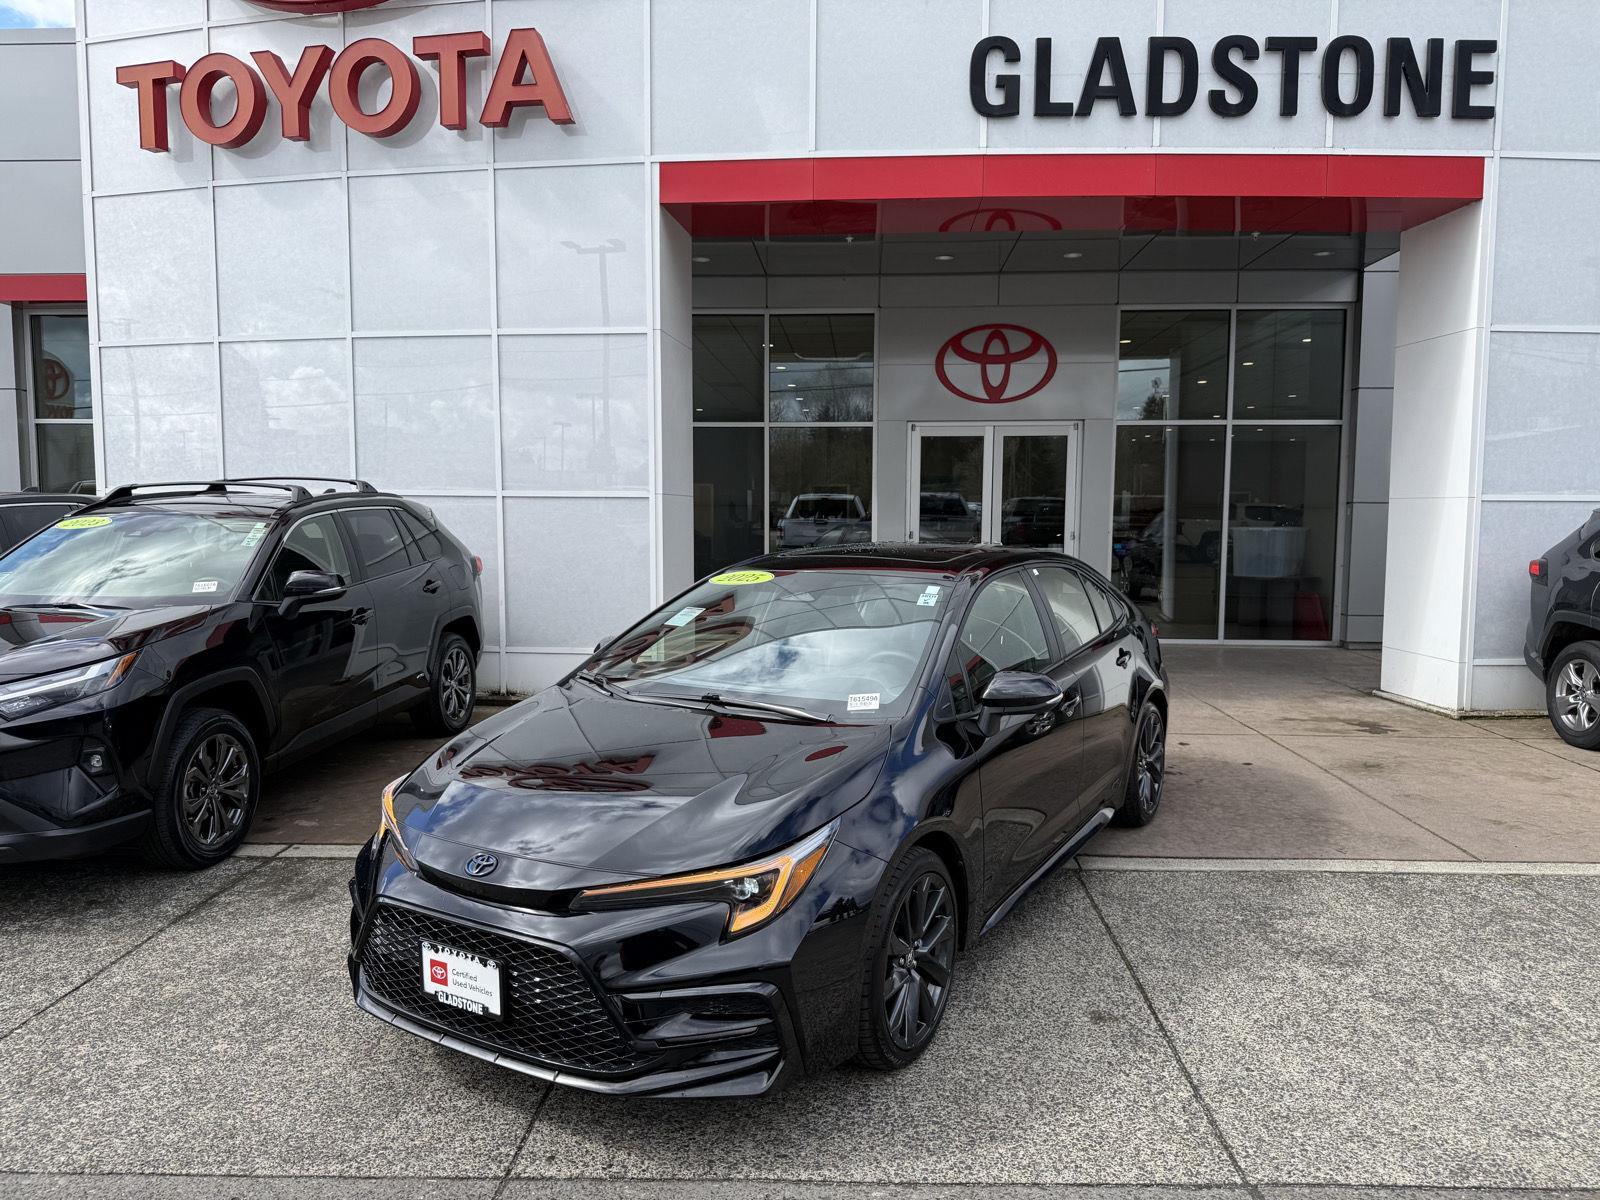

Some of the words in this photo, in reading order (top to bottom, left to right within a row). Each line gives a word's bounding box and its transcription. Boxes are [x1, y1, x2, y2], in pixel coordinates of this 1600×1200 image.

[969, 35, 1498, 119] GLADSTONE
[116, 28, 576, 153] TOYOTA
[437, 945, 480, 964] TOYOTA
[451, 968, 478, 983] Certified
[452, 977, 468, 989] Used
[468, 982, 494, 997] Vehicles
[437, 991, 484, 1015] GLADSTONE
